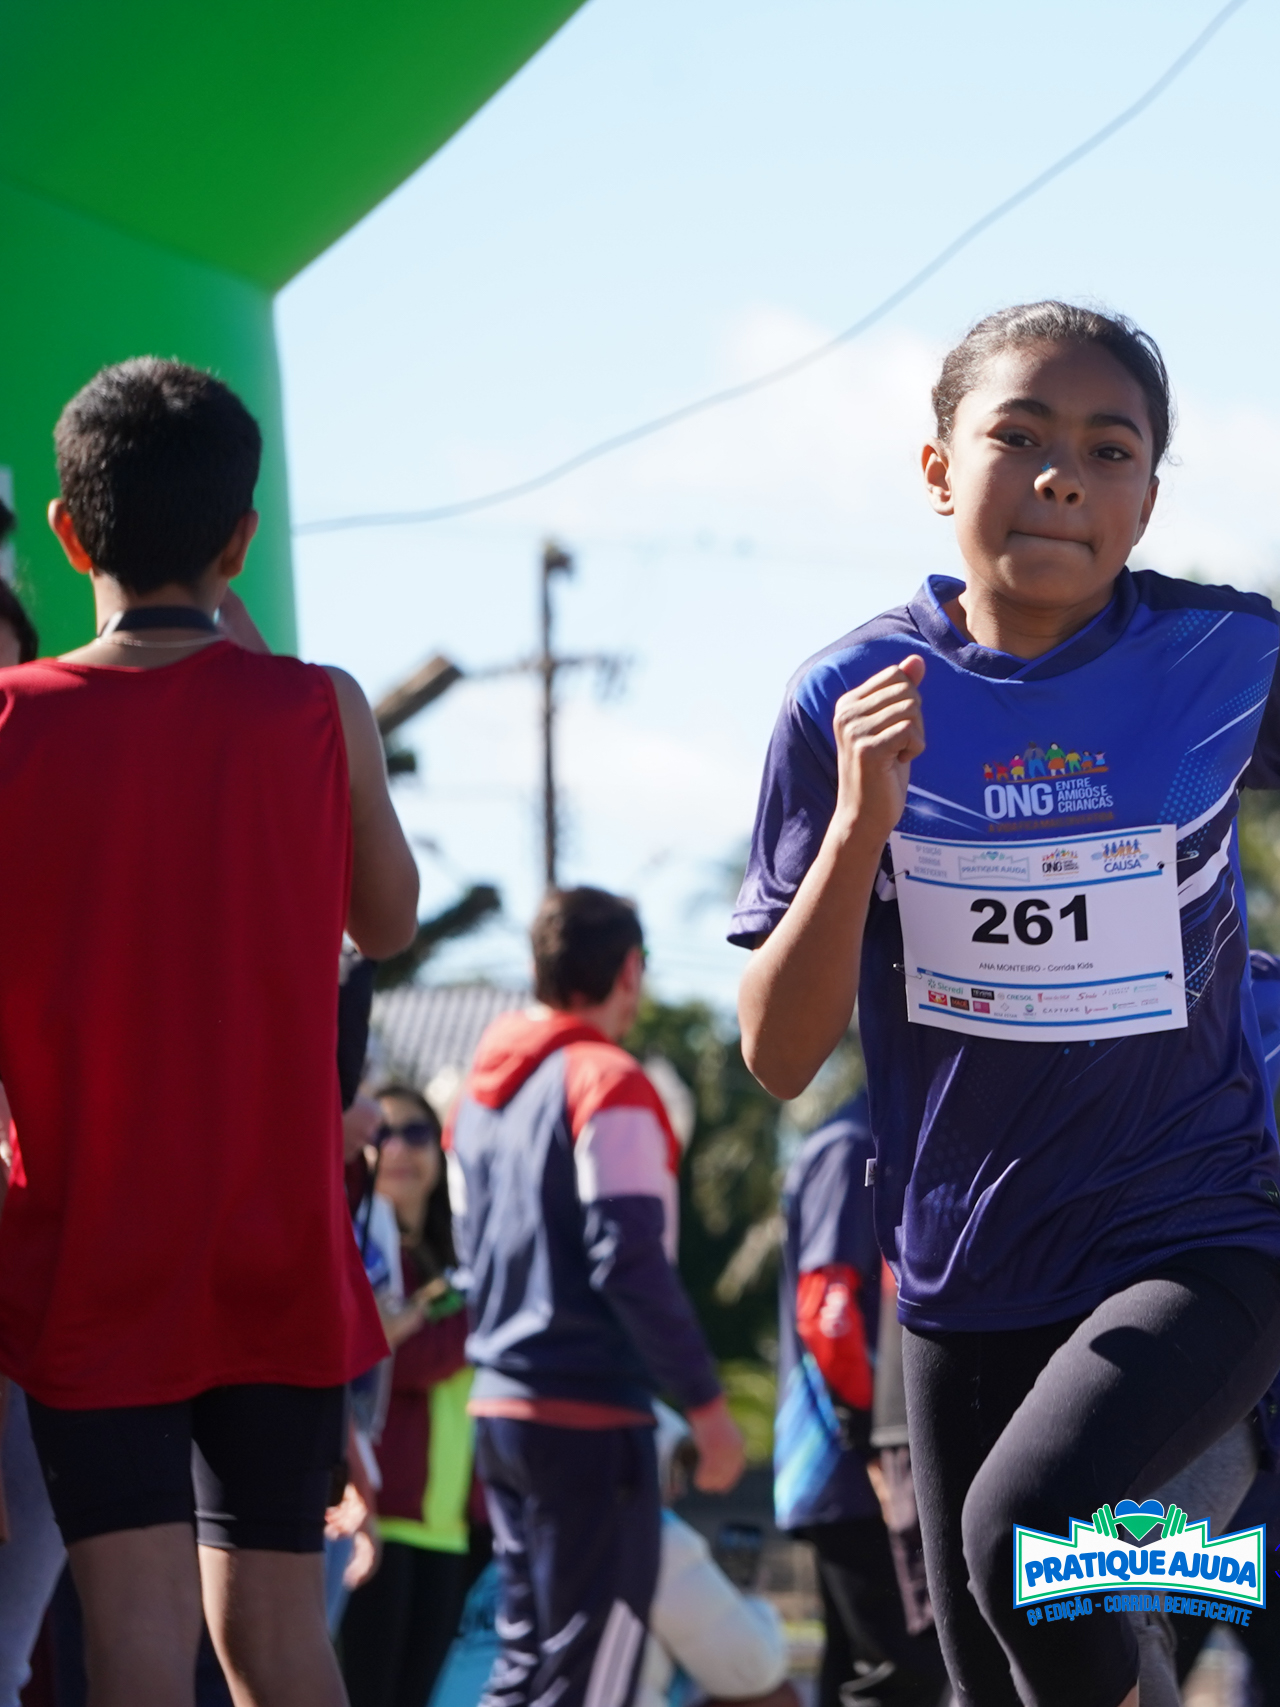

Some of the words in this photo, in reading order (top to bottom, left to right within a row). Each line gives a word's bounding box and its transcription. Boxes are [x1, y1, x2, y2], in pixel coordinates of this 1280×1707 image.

[1056, 777, 1091, 791] ENTRE
[984, 783, 1054, 820] ONG
[1104, 859, 1142, 873] CAUSA
[970, 894, 1088, 945] 261
[979, 962, 995, 971] ANA
[997, 963, 1040, 972] MONTEIRO
[1047, 963, 1075, 972] Corrida
[1077, 962, 1094, 970] Kids
[938, 982, 963, 994] Sicredi
